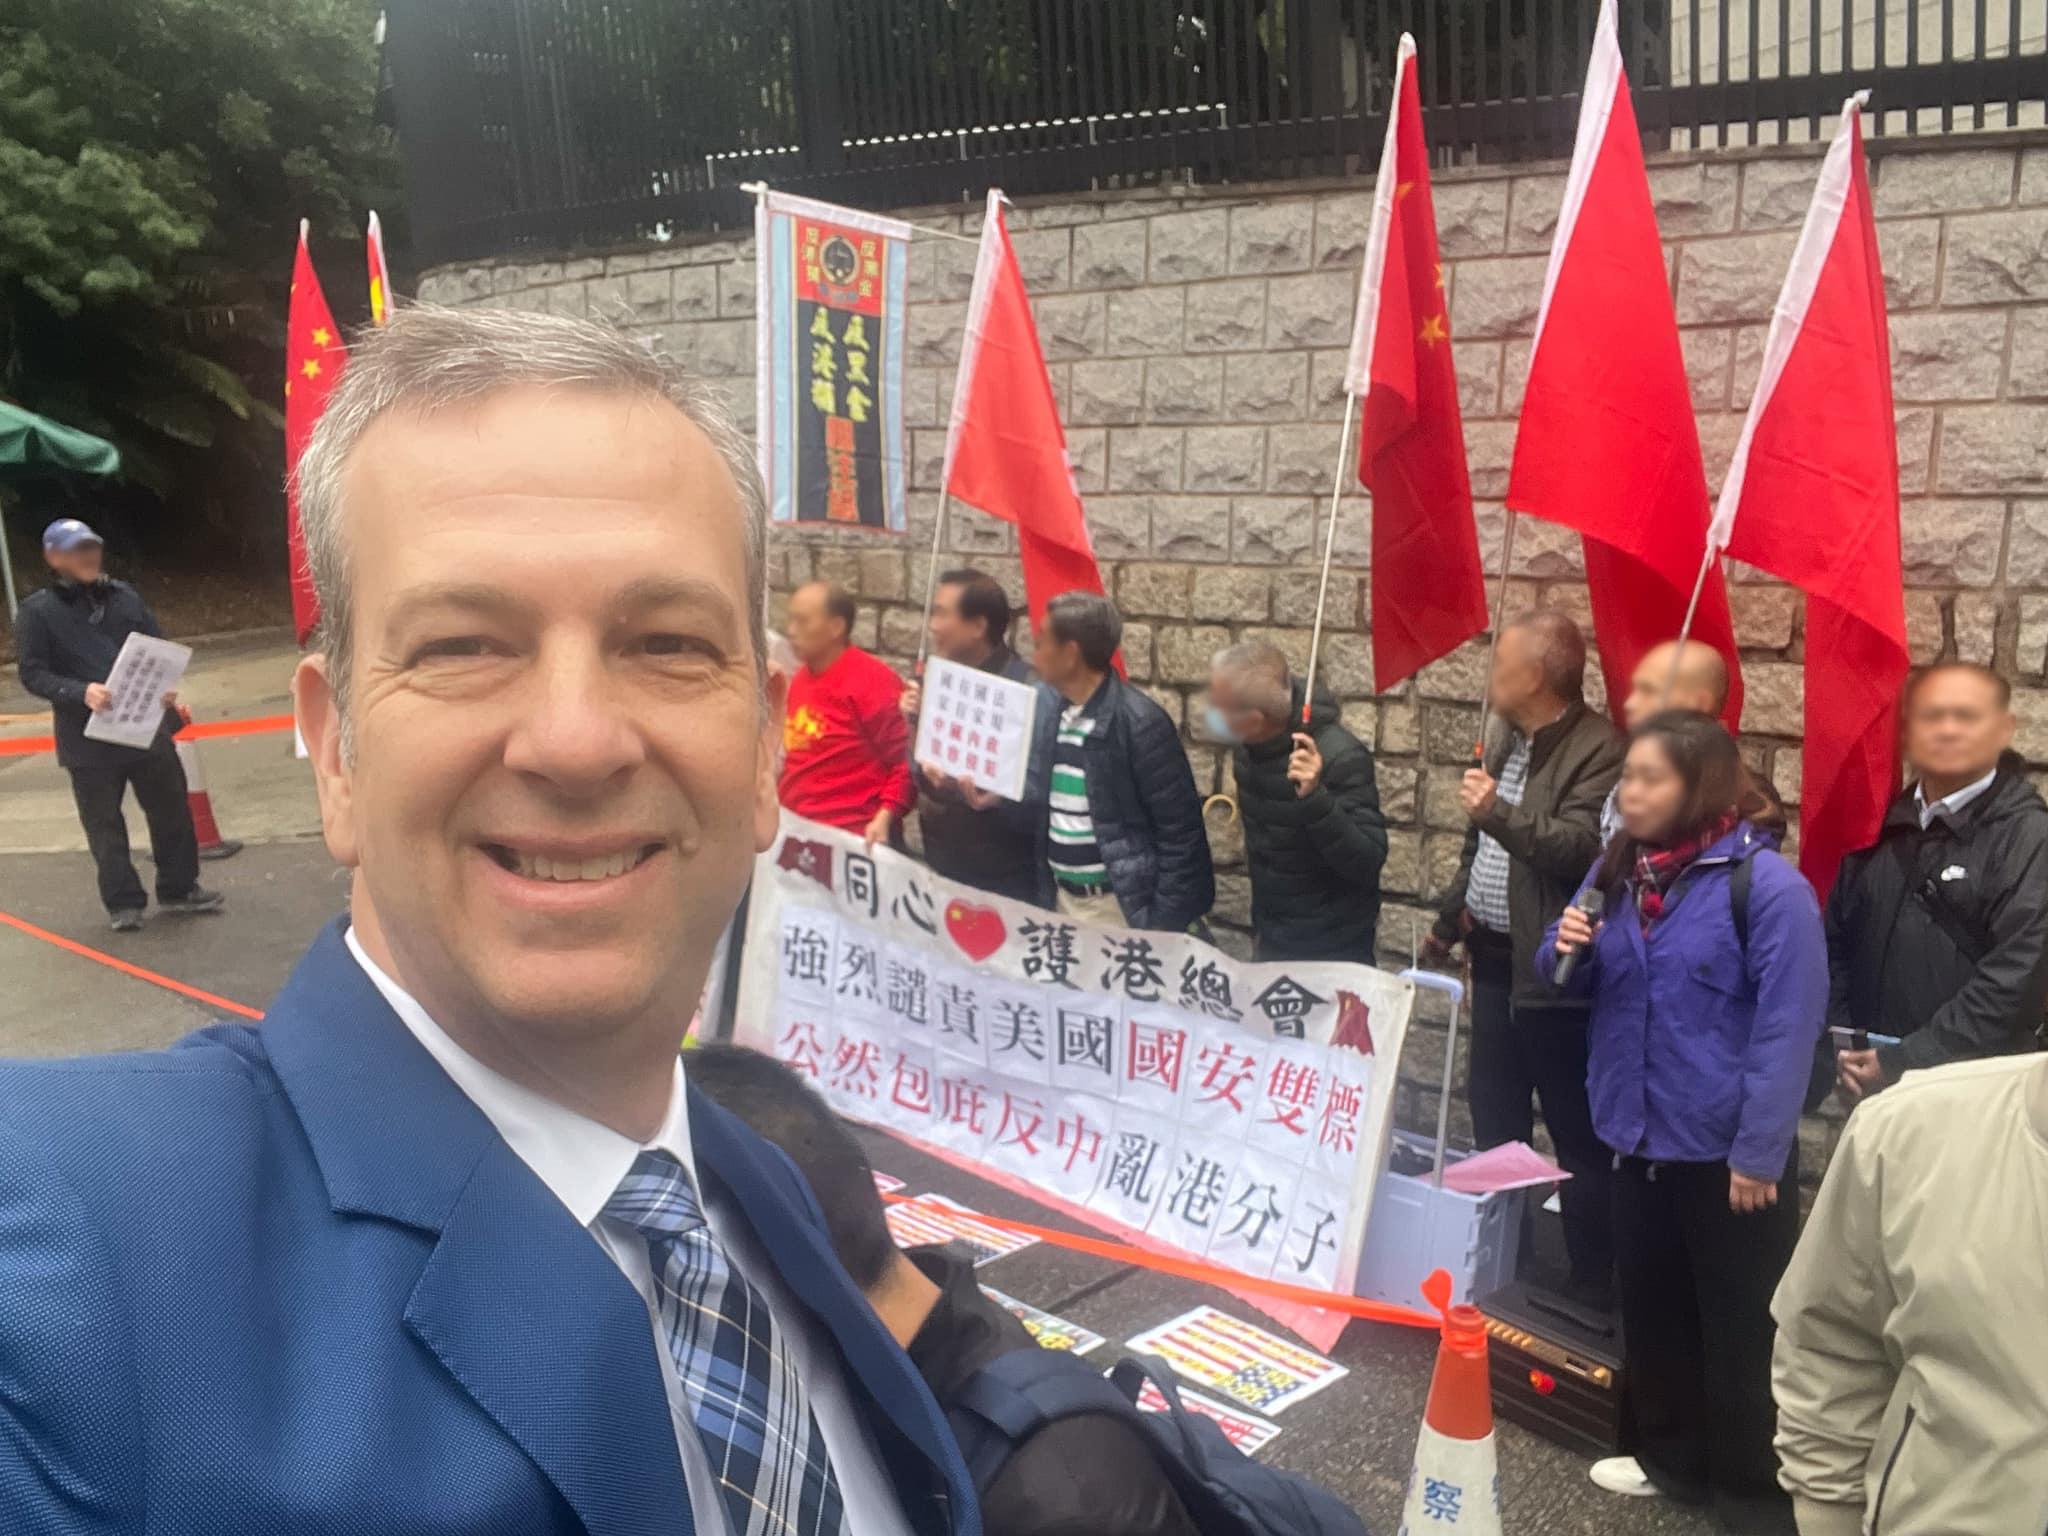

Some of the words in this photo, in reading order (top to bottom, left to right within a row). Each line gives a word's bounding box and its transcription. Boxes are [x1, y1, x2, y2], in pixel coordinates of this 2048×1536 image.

[778, 1020, 1337, 1274] 公然包庇反中亂港分子
[782, 923, 1362, 1154] 強烈譴責美國國安雙標
[1424, 1477, 1462, 1523] 察
